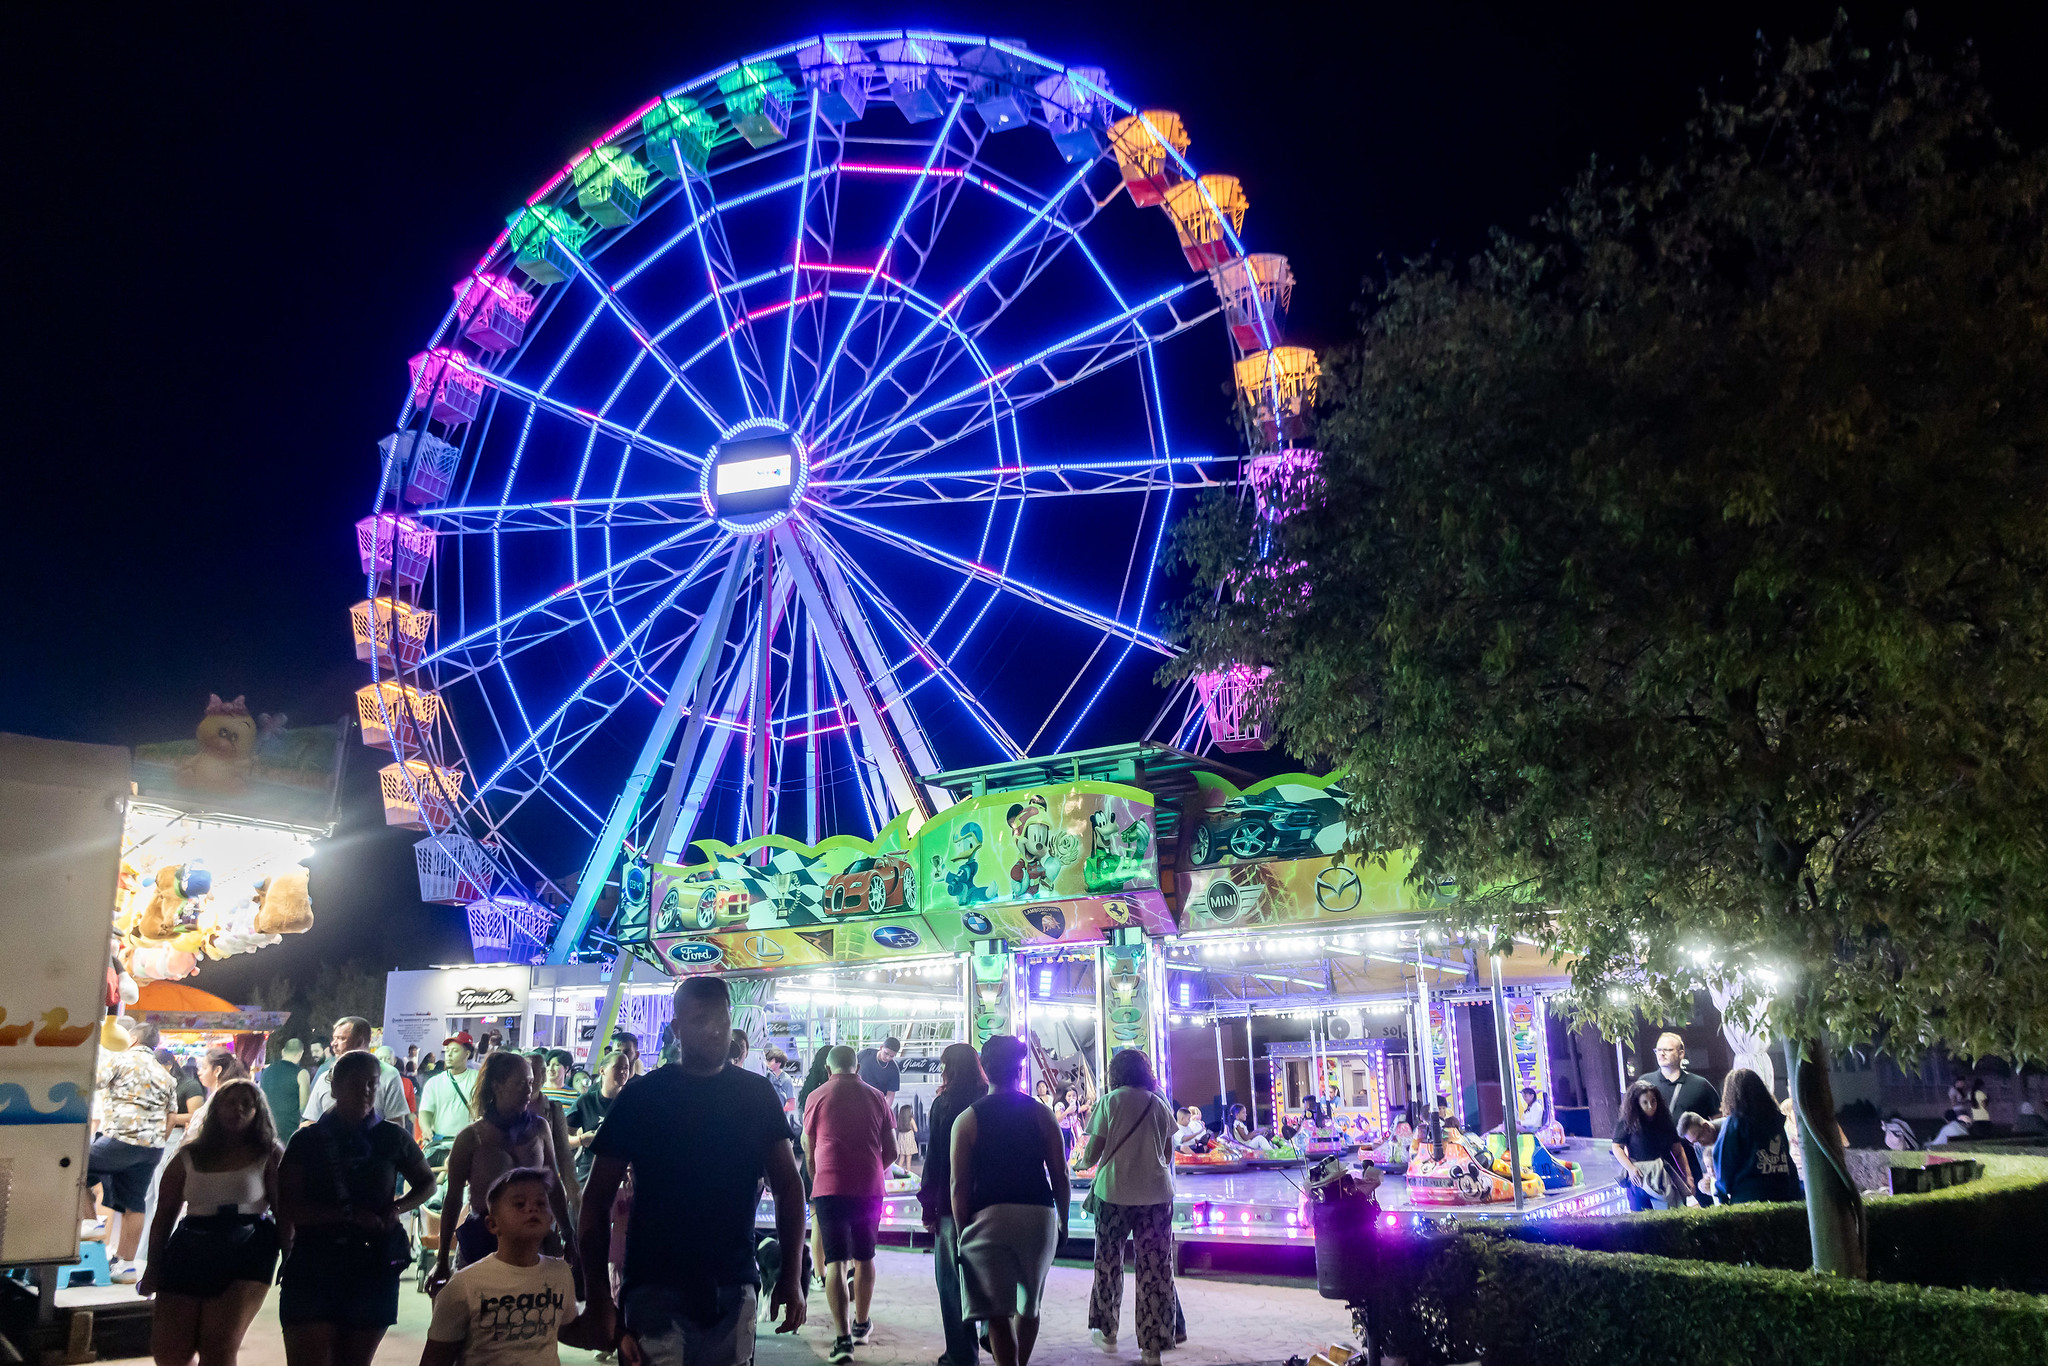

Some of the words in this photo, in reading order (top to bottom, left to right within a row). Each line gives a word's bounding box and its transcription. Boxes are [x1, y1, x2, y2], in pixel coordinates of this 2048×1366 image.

[1210, 893, 1237, 908] MINI
[1023, 905, 1061, 916] LAMBORGHINI
[680, 945, 712, 960] Ford
[459, 988, 513, 1010] Taquilla
[901, 1058, 928, 1073] Giant
[481, 1288, 564, 1314] ready
